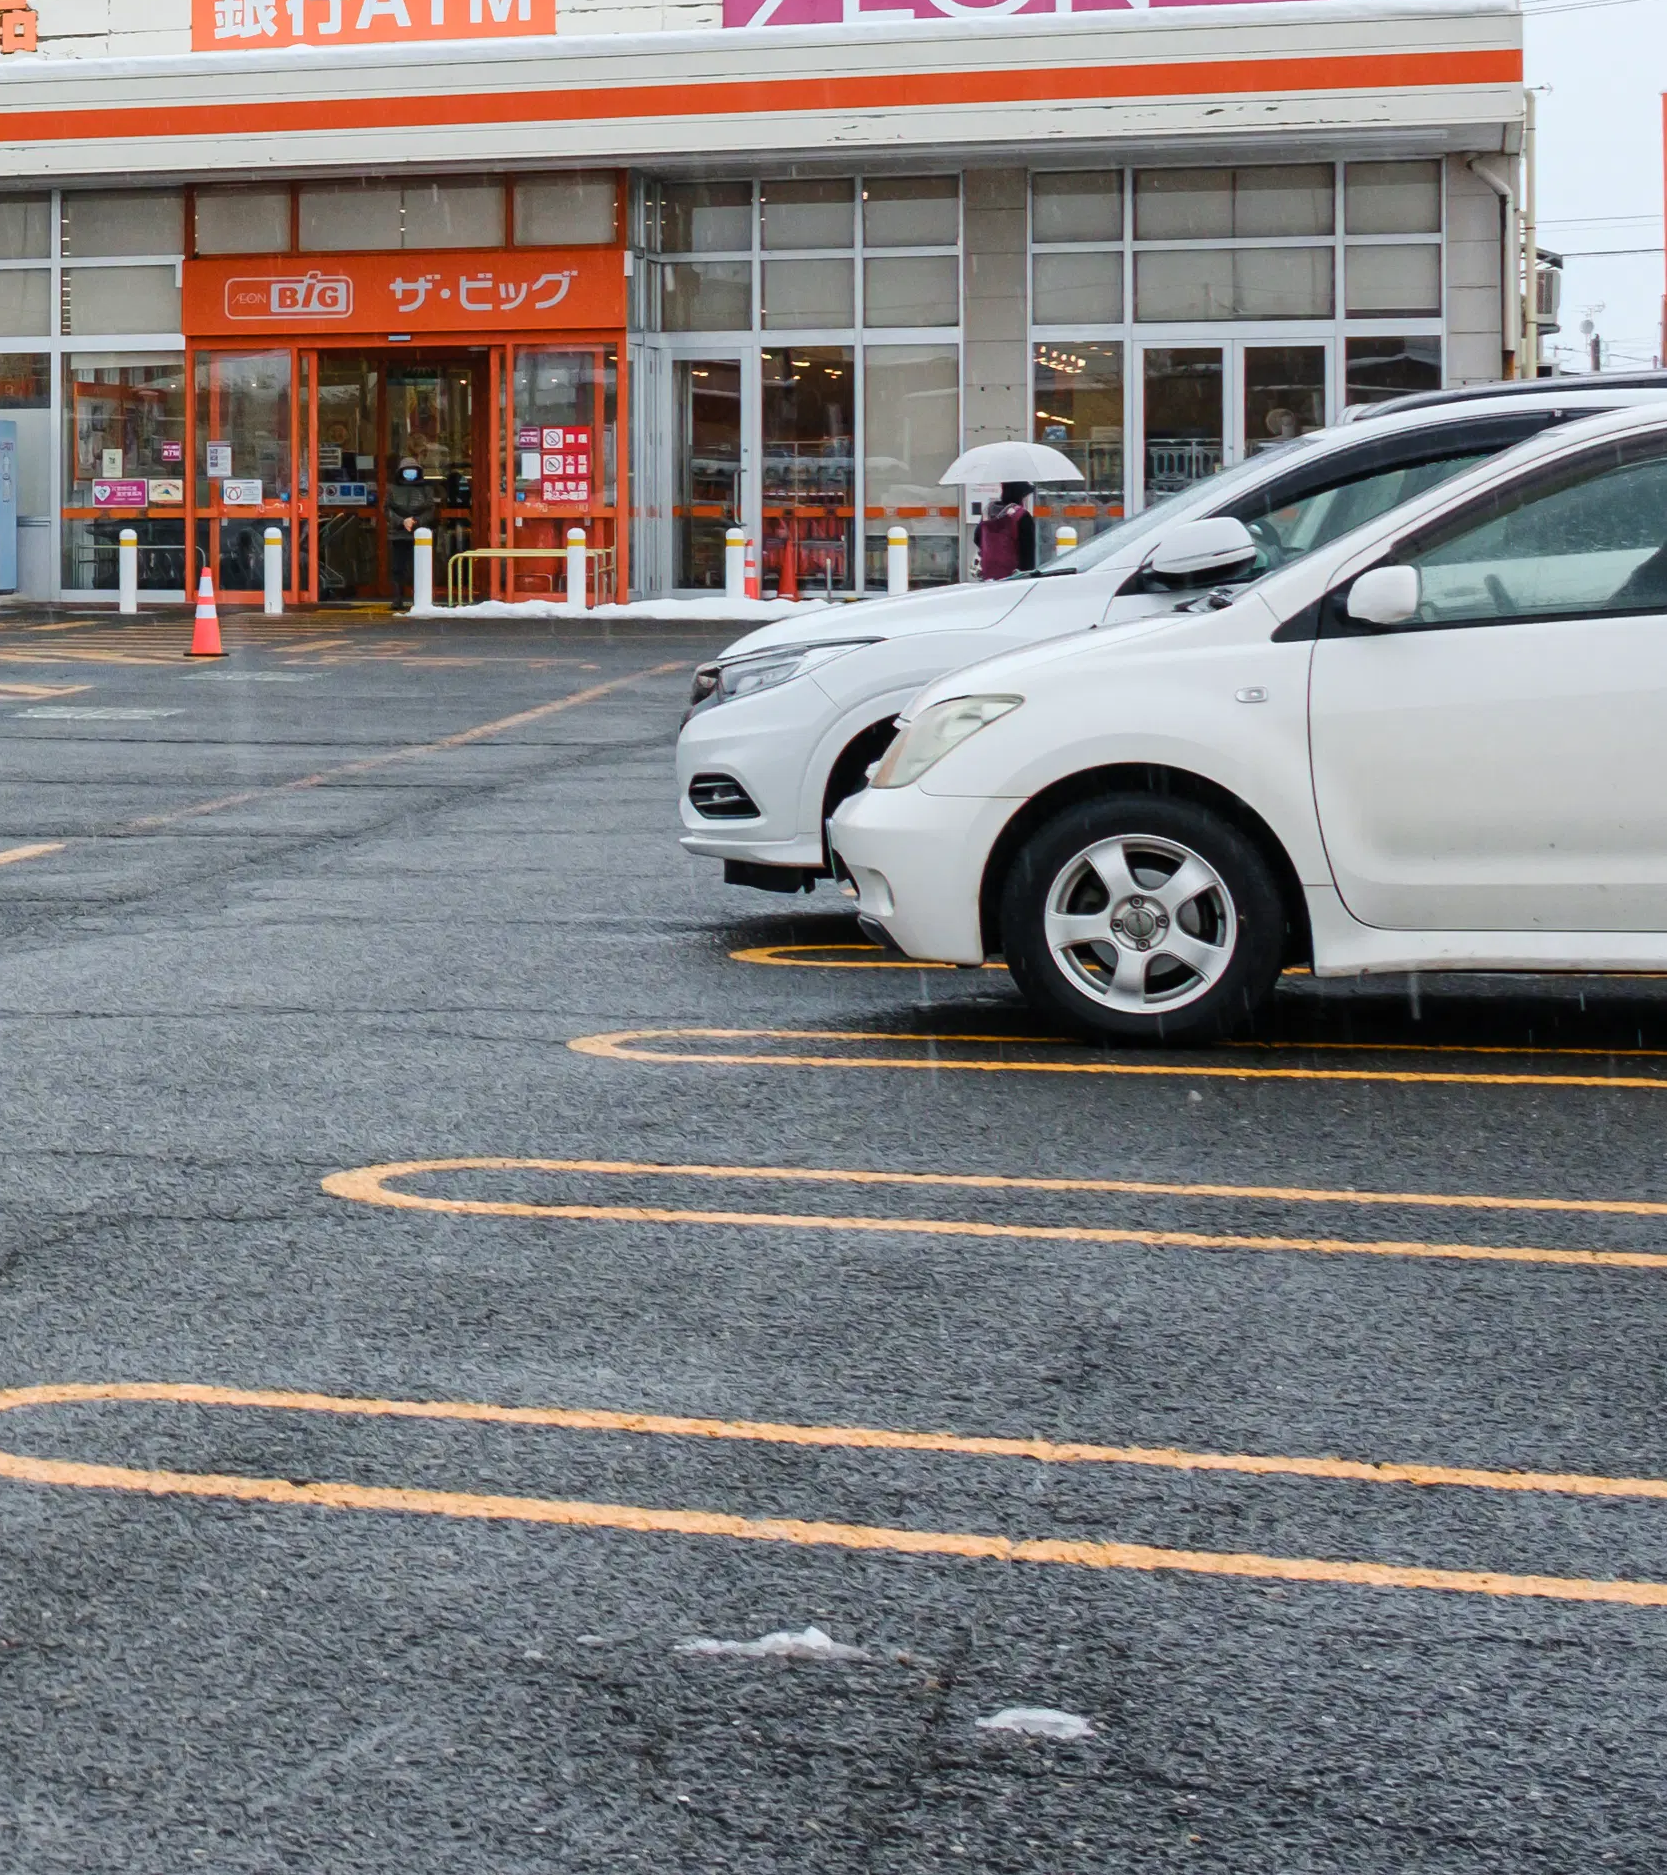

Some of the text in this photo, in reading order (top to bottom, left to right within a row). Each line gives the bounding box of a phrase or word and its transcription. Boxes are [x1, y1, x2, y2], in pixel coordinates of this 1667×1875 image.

[389, 270, 578, 312] ザ・ビッグ
